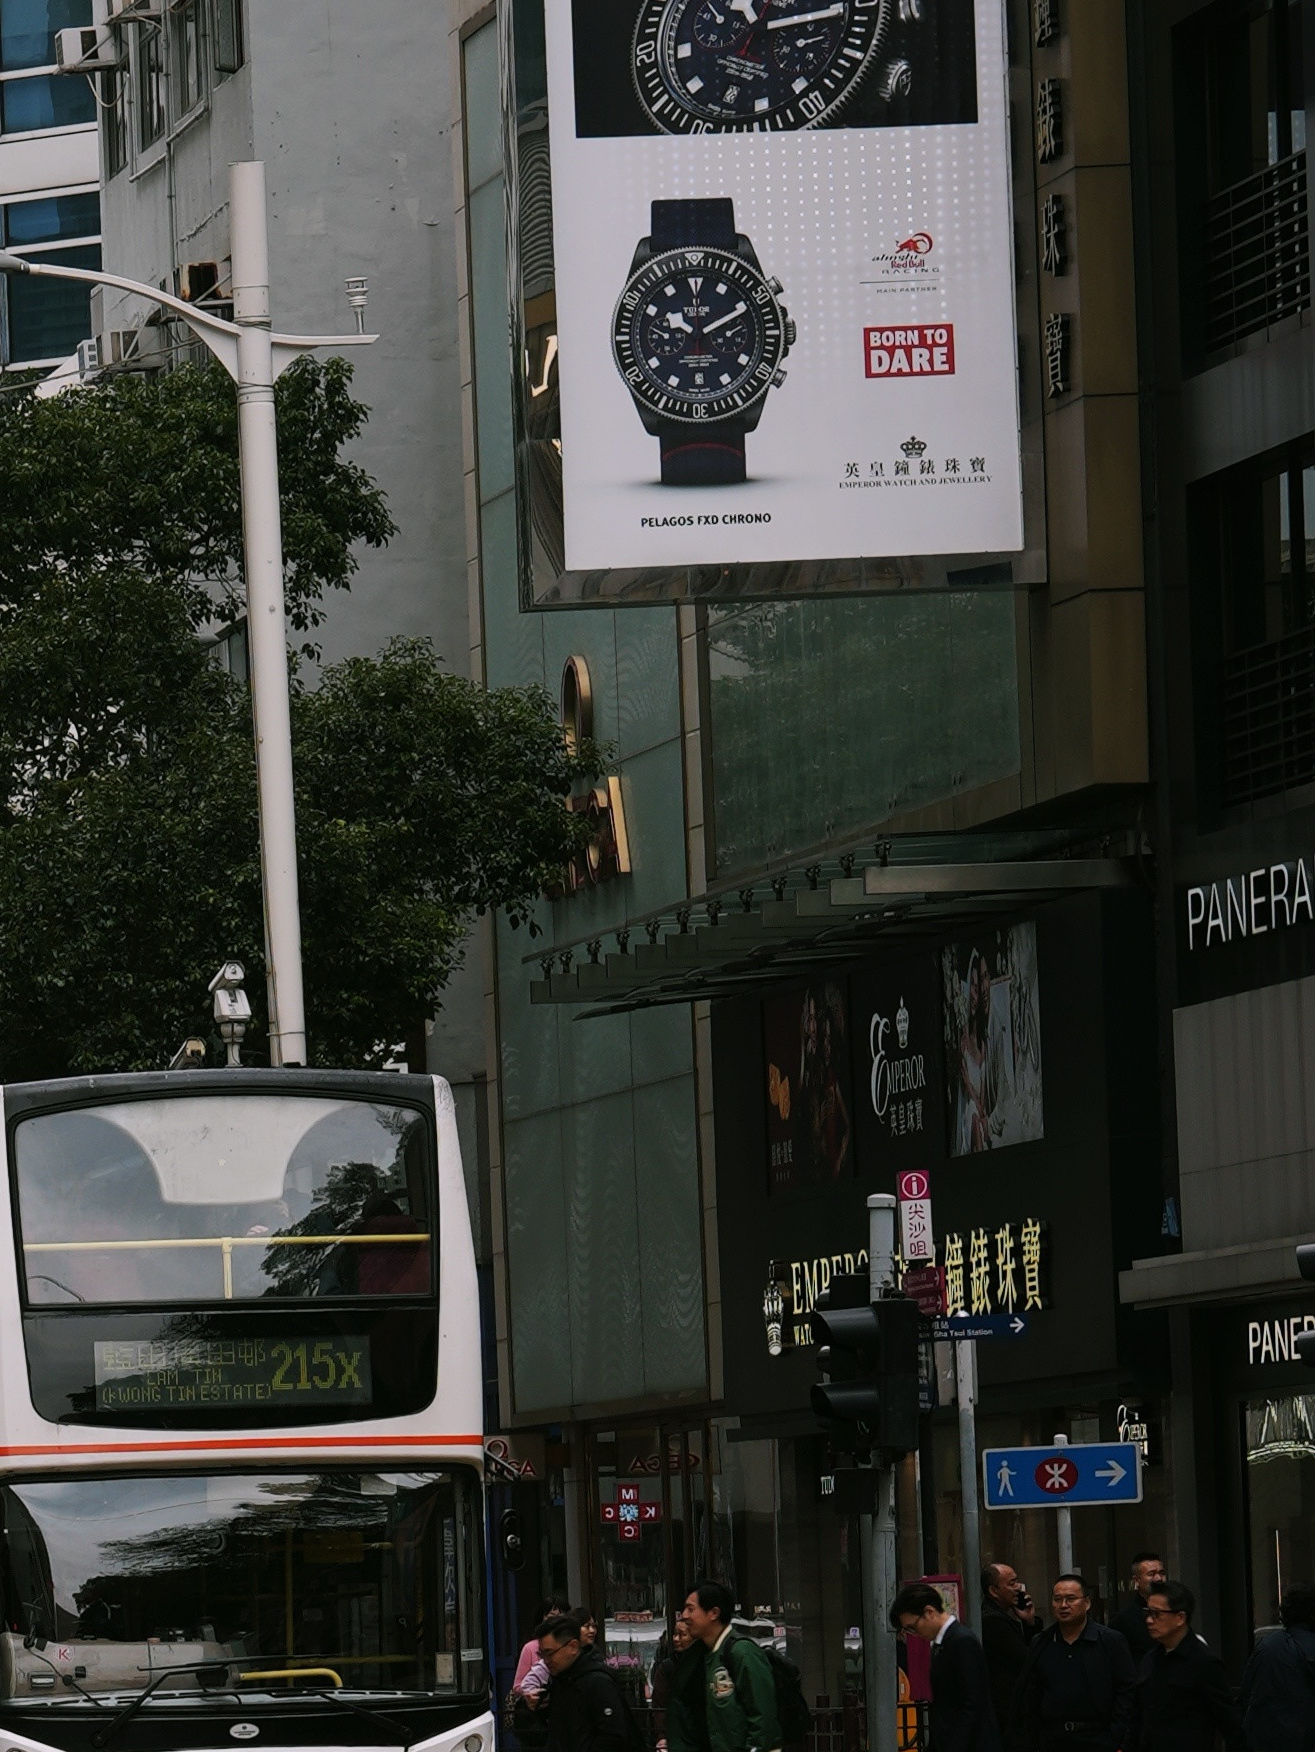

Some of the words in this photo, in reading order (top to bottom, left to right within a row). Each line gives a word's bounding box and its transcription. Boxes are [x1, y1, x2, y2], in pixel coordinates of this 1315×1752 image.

[636, 40, 656, 67] 20
[799, 90, 827, 119] 40
[890, 259, 907, 269] Red
[907, 258, 925, 268] Bull
[752, 285, 770, 305] 50
[869, 329, 920, 347] BORN
[923, 328, 948, 346] TO
[869, 347, 950, 374] DARE
[625, 366, 643, 386] 20
[754, 362, 773, 380] 40
[692, 403, 709, 419] 30
[843, 457, 987, 479] 英皇鐘錶珠寶
[839, 479, 883, 489] EMPEROR
[883, 478, 917, 488] WATCH
[918, 477, 937, 486] AND
[938, 474, 993, 485] JEWELLERY
[640, 515, 694, 528] PELAGOS
[697, 514, 719, 526] FXD
[722, 512, 772, 525] CHRONO
[1187, 855, 1315, 950] PANERA
[870, 1012, 926, 1124] EMPEROR
[907, 1201, 929, 1257] 尖沙咀
[966, 1328, 994, 1337] Station
[195, 1368, 222, 1384] TIN
[169, 1385, 196, 1402] TIN
